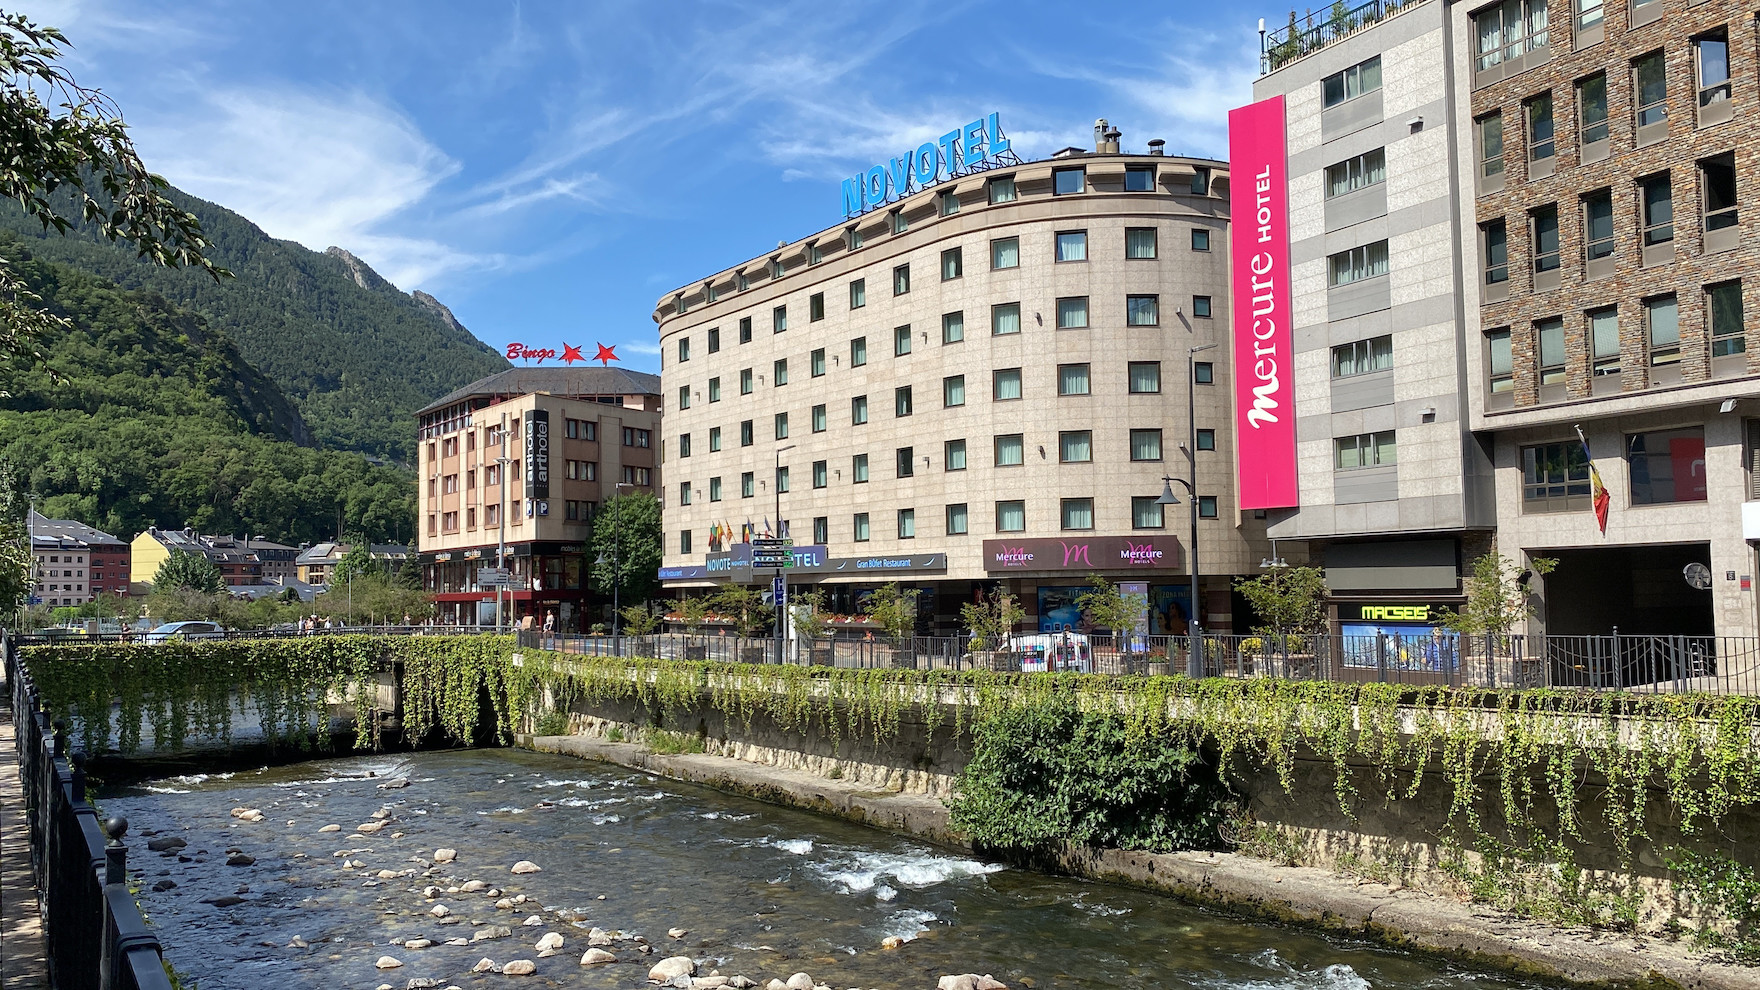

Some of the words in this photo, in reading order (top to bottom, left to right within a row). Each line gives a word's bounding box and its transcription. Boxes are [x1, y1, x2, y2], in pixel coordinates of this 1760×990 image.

[840, 111, 1011, 218] NOVOTEL
[1257, 164, 1272, 243] HOTEL
[506, 342, 556, 364] Bingo
[526, 420, 534, 482] arthotel
[536, 420, 548, 482] arthotel
[540, 502, 548, 514] P
[996, 552, 1034, 562] Mercure
[1120, 549, 1163, 559] Mercure
[706, 557, 731, 571] NOVOTE
[856, 559, 868, 569] Gran
[883, 558, 912, 568] Restaurant
[1361, 605, 1428, 620] MACSEIS
